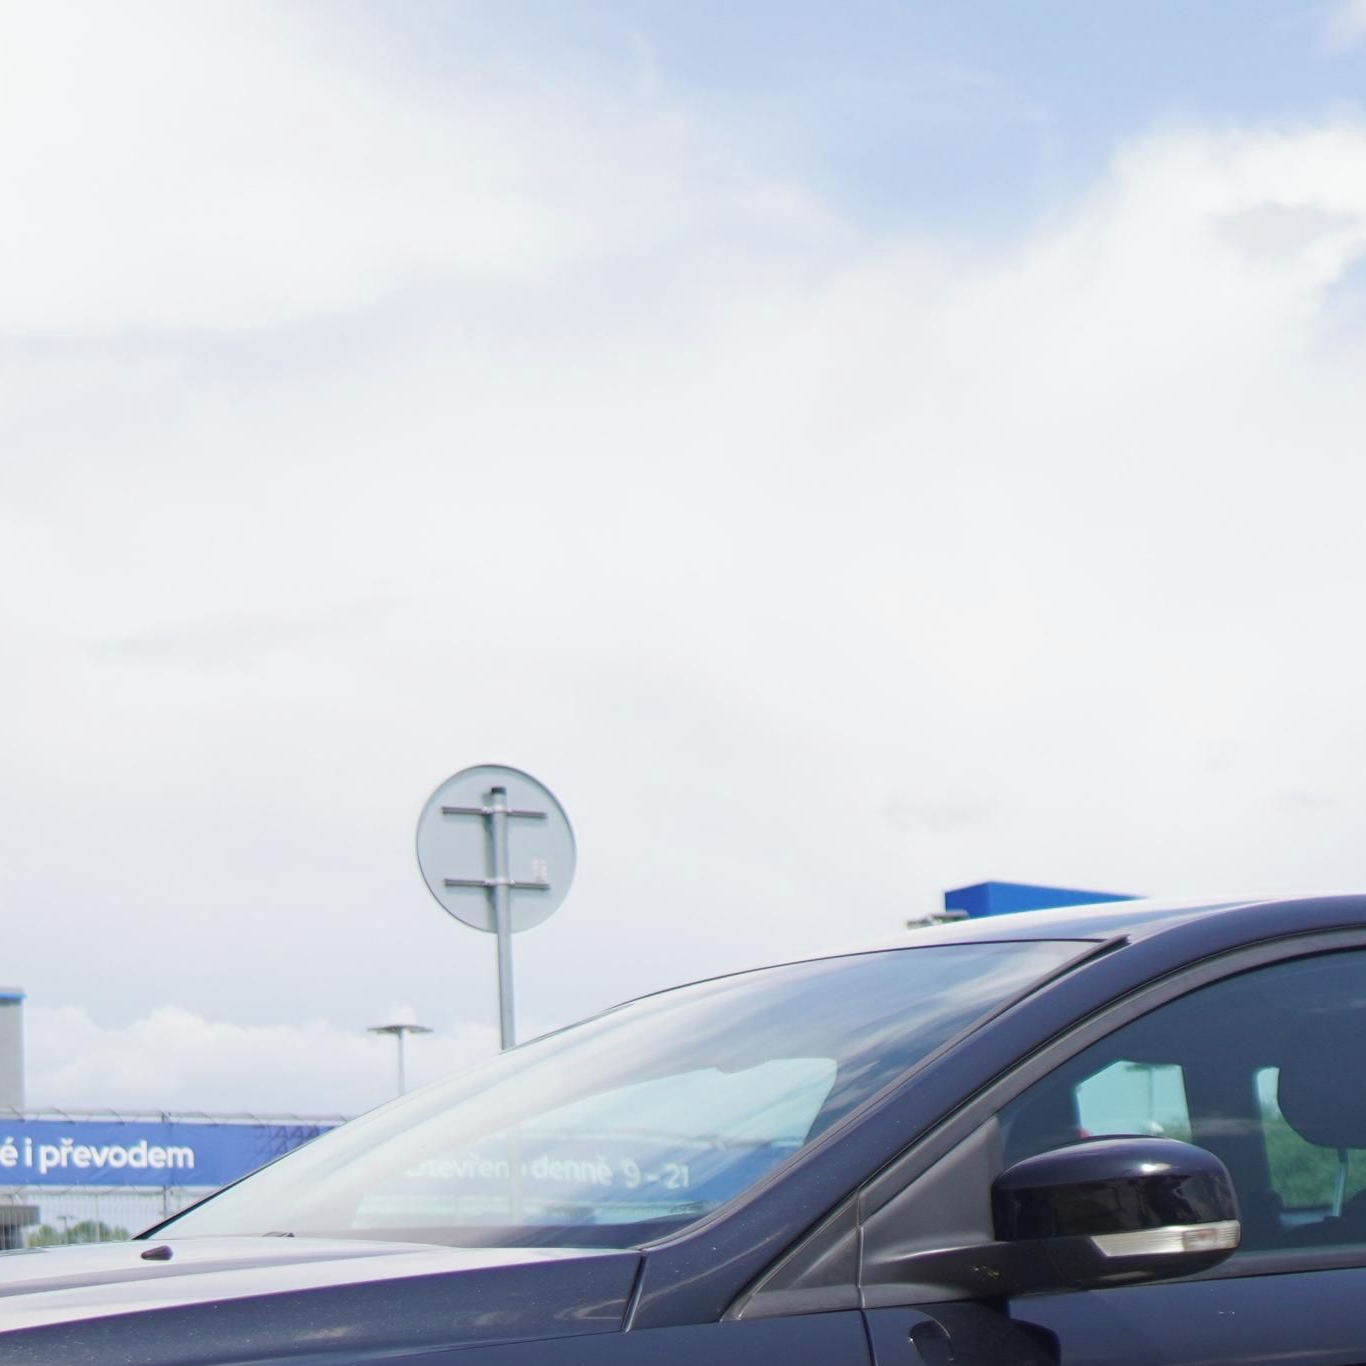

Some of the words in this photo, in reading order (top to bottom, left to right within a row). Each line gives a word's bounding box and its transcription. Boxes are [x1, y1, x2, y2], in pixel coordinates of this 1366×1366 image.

[24, 1137, 33, 1168] i
[39, 1137, 195, 1175] převodem
[532, 1155, 613, 1186] denně
[621, 1157, 641, 1188] 9
[665, 1161, 691, 1190] 21
